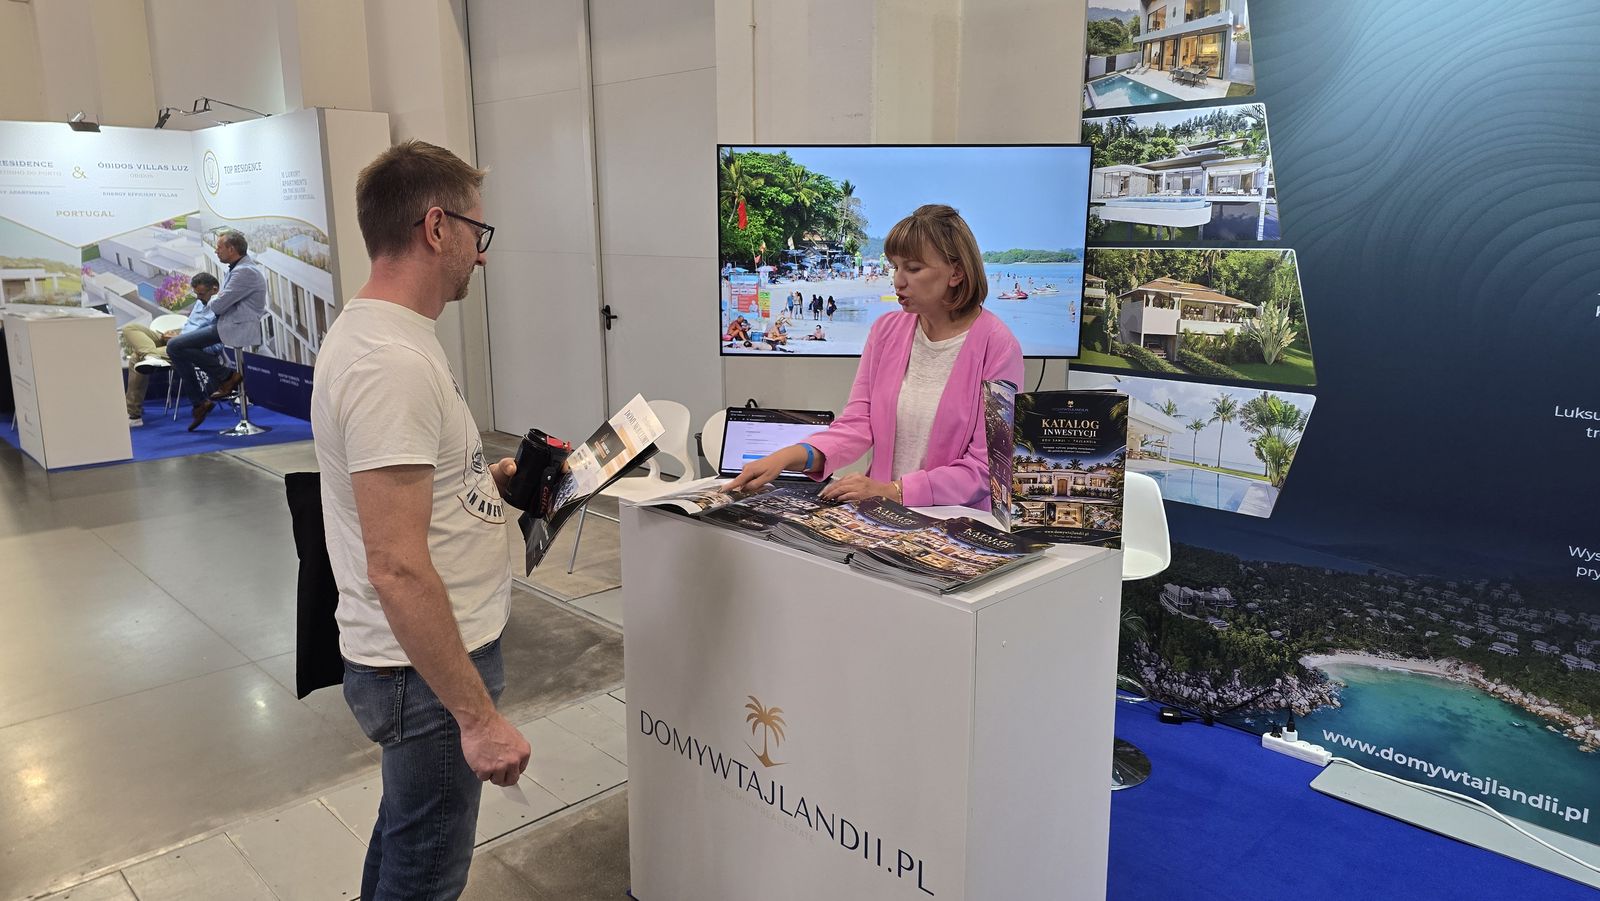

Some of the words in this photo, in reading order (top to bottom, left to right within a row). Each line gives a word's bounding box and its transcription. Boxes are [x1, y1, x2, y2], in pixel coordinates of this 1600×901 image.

[72, 166, 87, 179] &
[136, 163, 169, 171] VILLAS
[171, 164, 190, 172] LUZ
[223, 165, 233, 174] TOP
[233, 161, 262, 173] RESIDENCE
[56, 209, 115, 218] PORTUGAL
[1042, 418, 1100, 430] KATALOG
[1044, 428, 1097, 438] INWESTYCJI
[1322, 728, 1590, 825] www.domywtajlandii.pl
[640, 709, 935, 897] DOMYWTAJLANDII.PL
